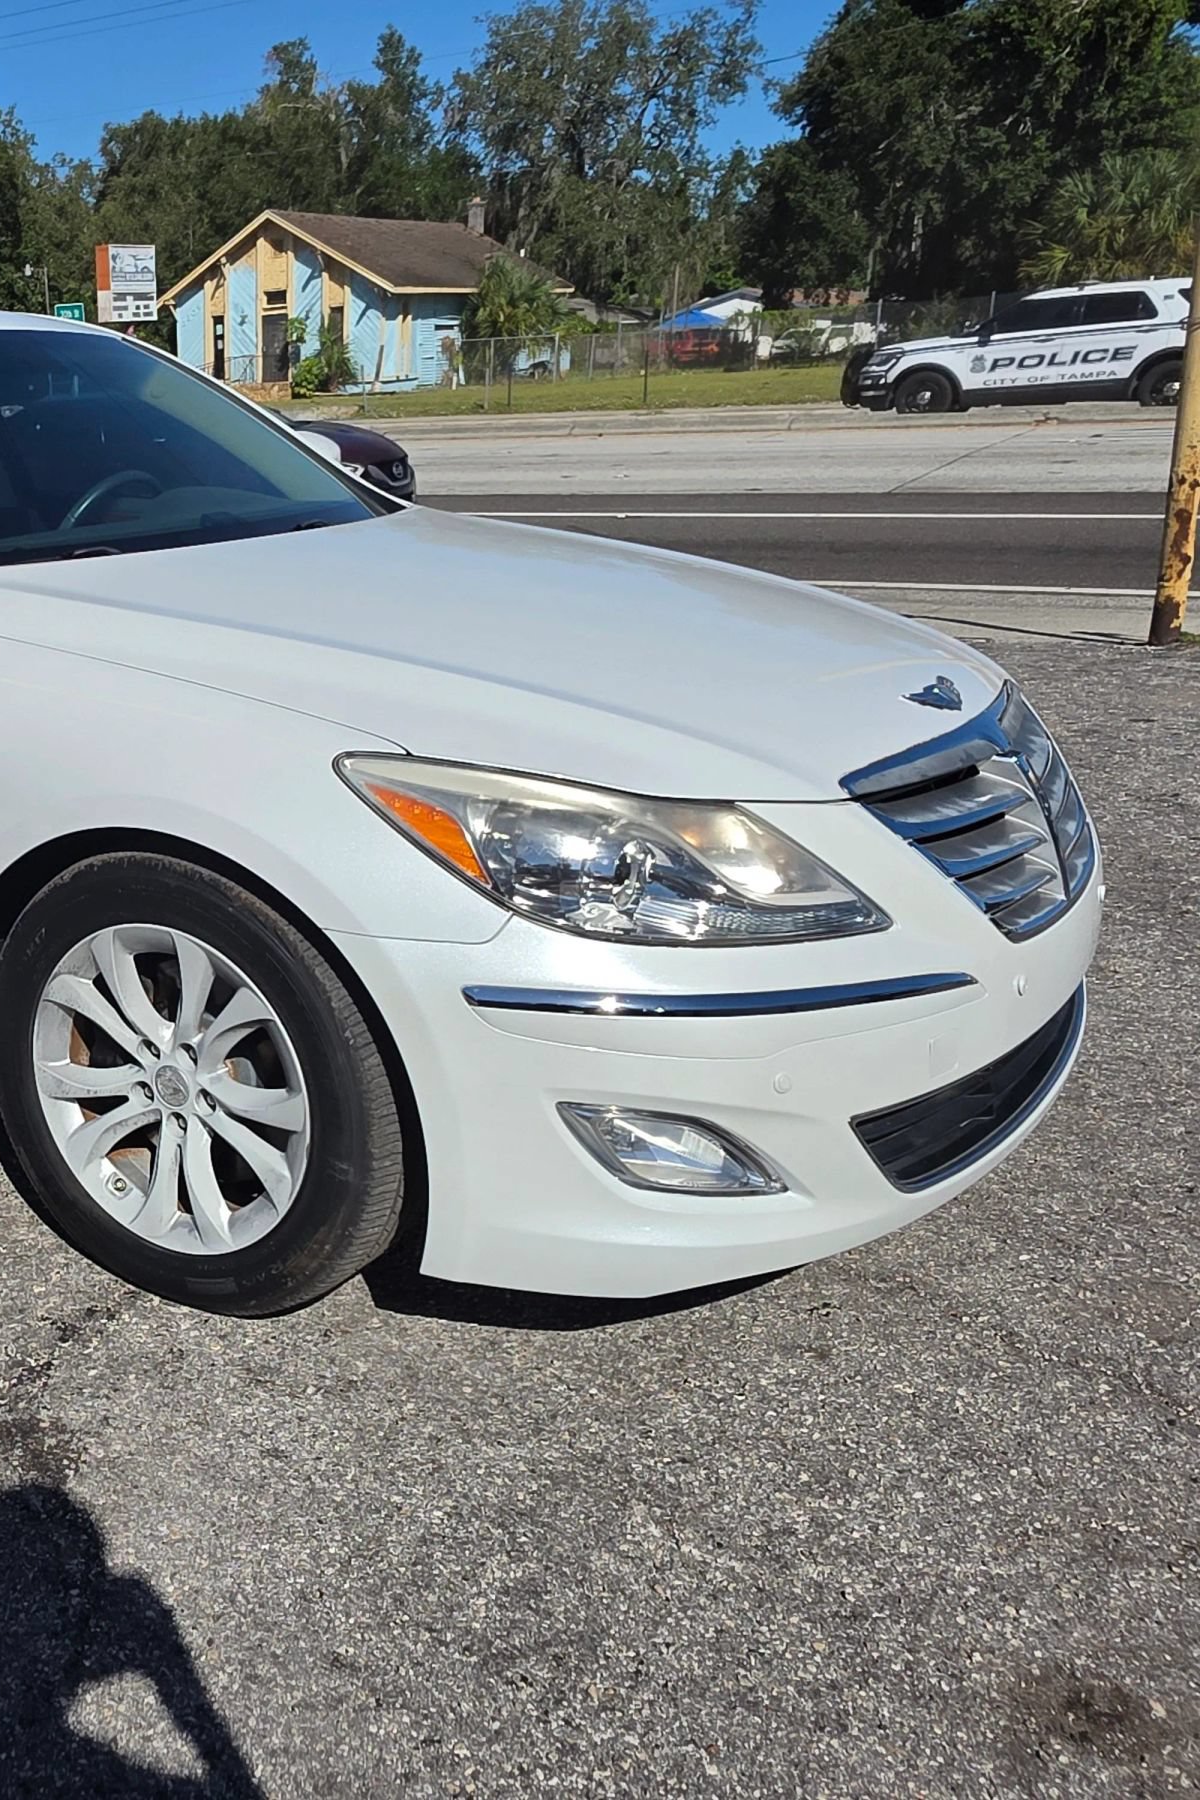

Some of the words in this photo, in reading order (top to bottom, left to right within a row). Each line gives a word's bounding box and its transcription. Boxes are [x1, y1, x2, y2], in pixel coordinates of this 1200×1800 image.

[987, 346, 1138, 373] POLICE
[983, 378, 1018, 386] CITY
[1058, 370, 1118, 380] TAMPA
